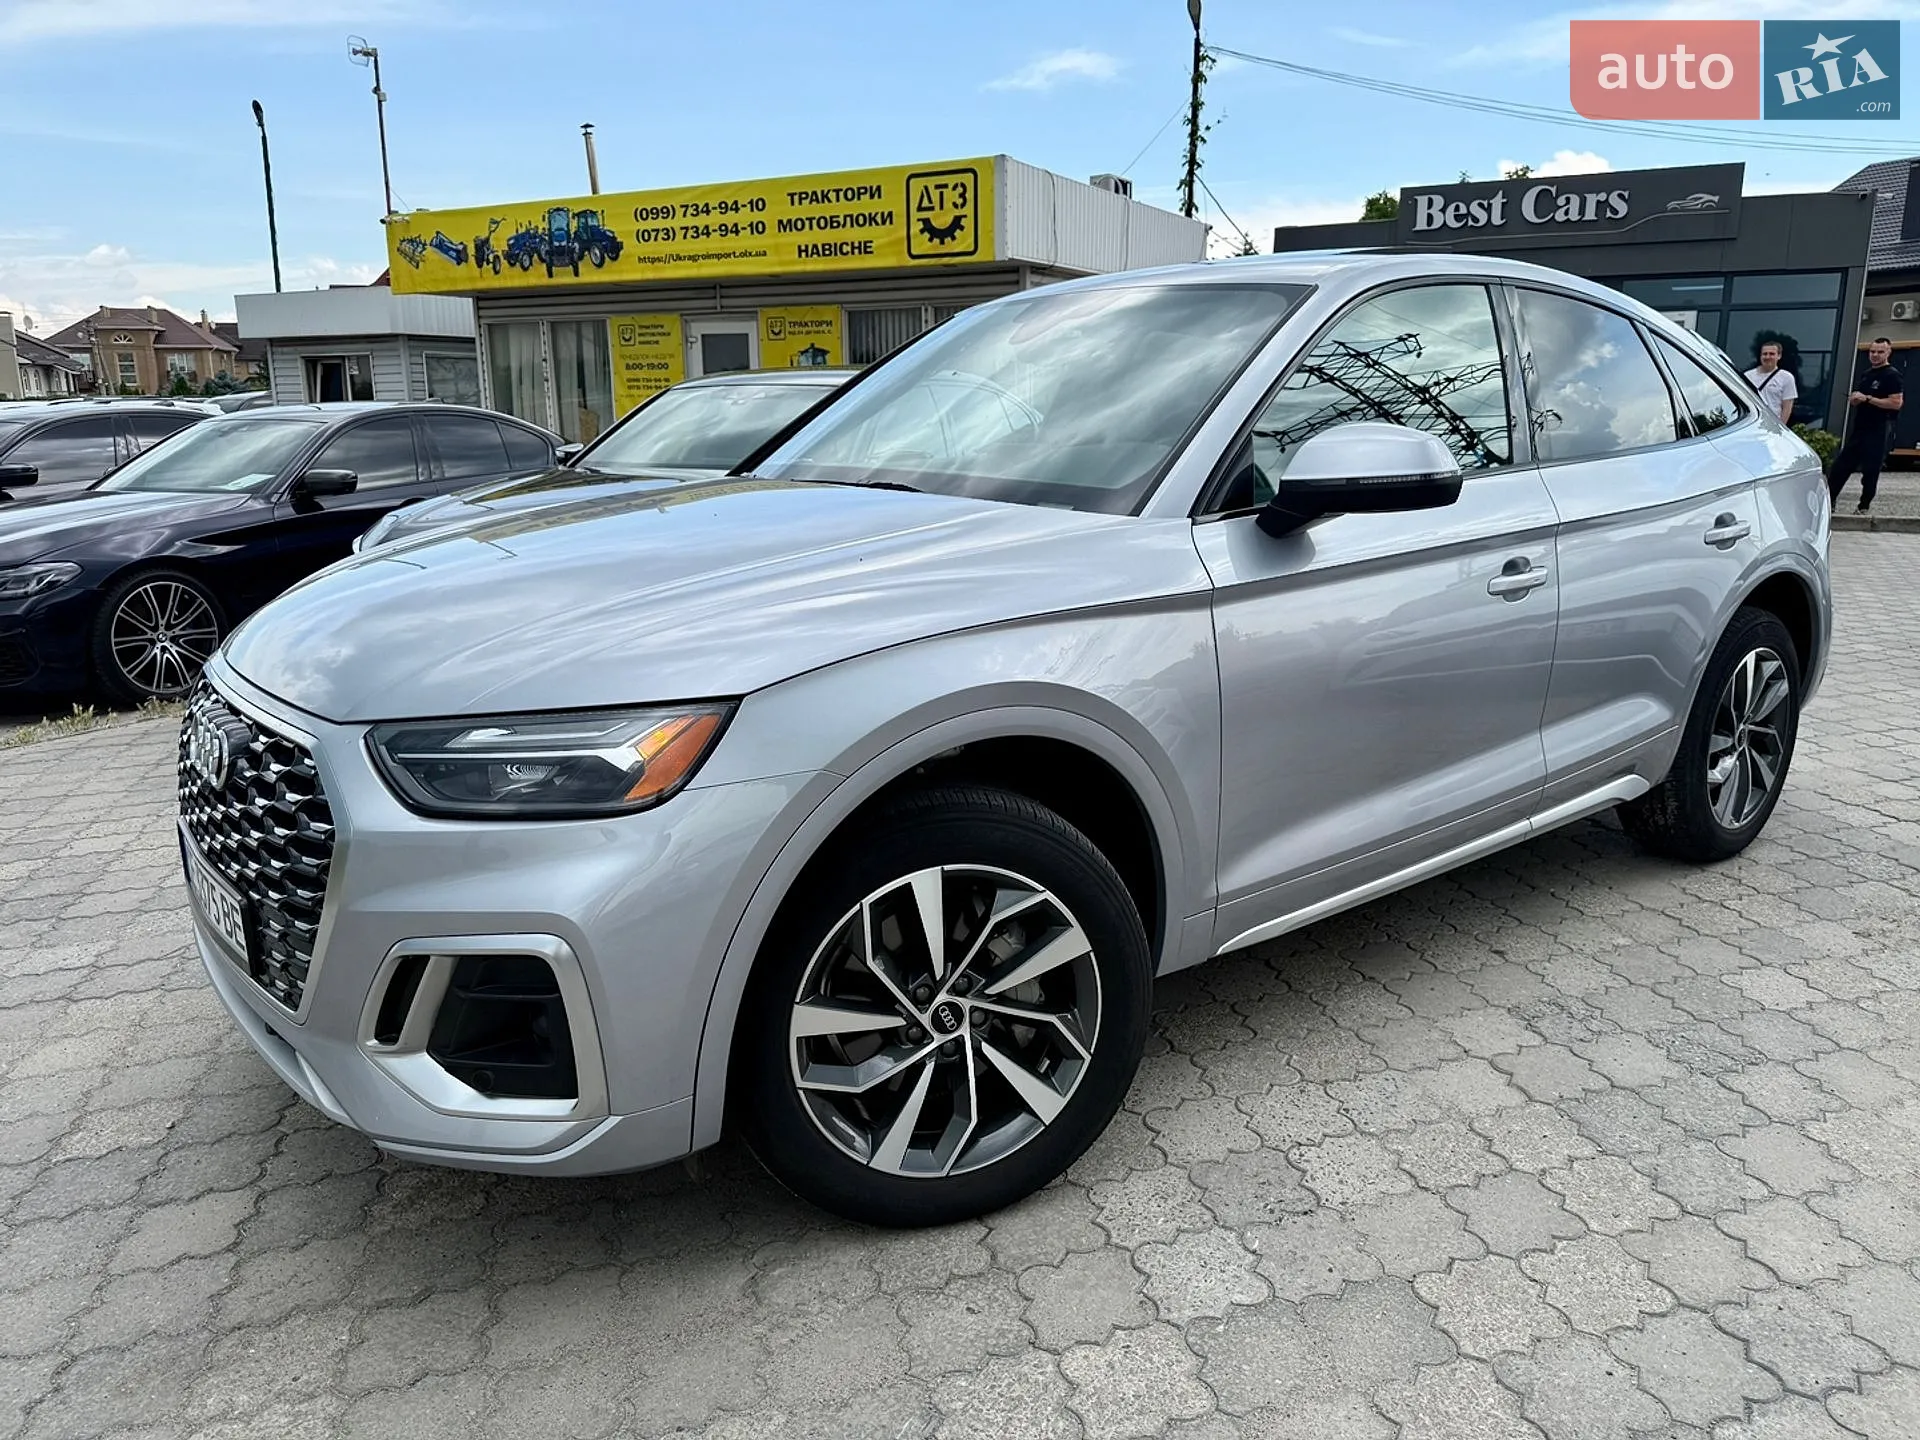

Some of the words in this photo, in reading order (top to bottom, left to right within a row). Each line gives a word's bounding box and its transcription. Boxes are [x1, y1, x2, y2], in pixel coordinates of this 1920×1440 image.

[787, 184, 882, 206] ТРАКТОРИ
[916, 181, 967, 212] ДТЗ
[634, 204, 677, 222] (099)
[680, 197, 767, 218] 734-94-10
[1412, 190, 1508, 232] Best
[1521, 184, 1630, 224] Cars
[635, 226, 677, 244] (073)
[680, 220, 767, 240] 734-94-10
[777, 210, 894, 233] МОТОБЛОКИ
[797, 240, 874, 258] НАВІСНЕ
[787, 319, 833, 328] ТРАКТОРИ
